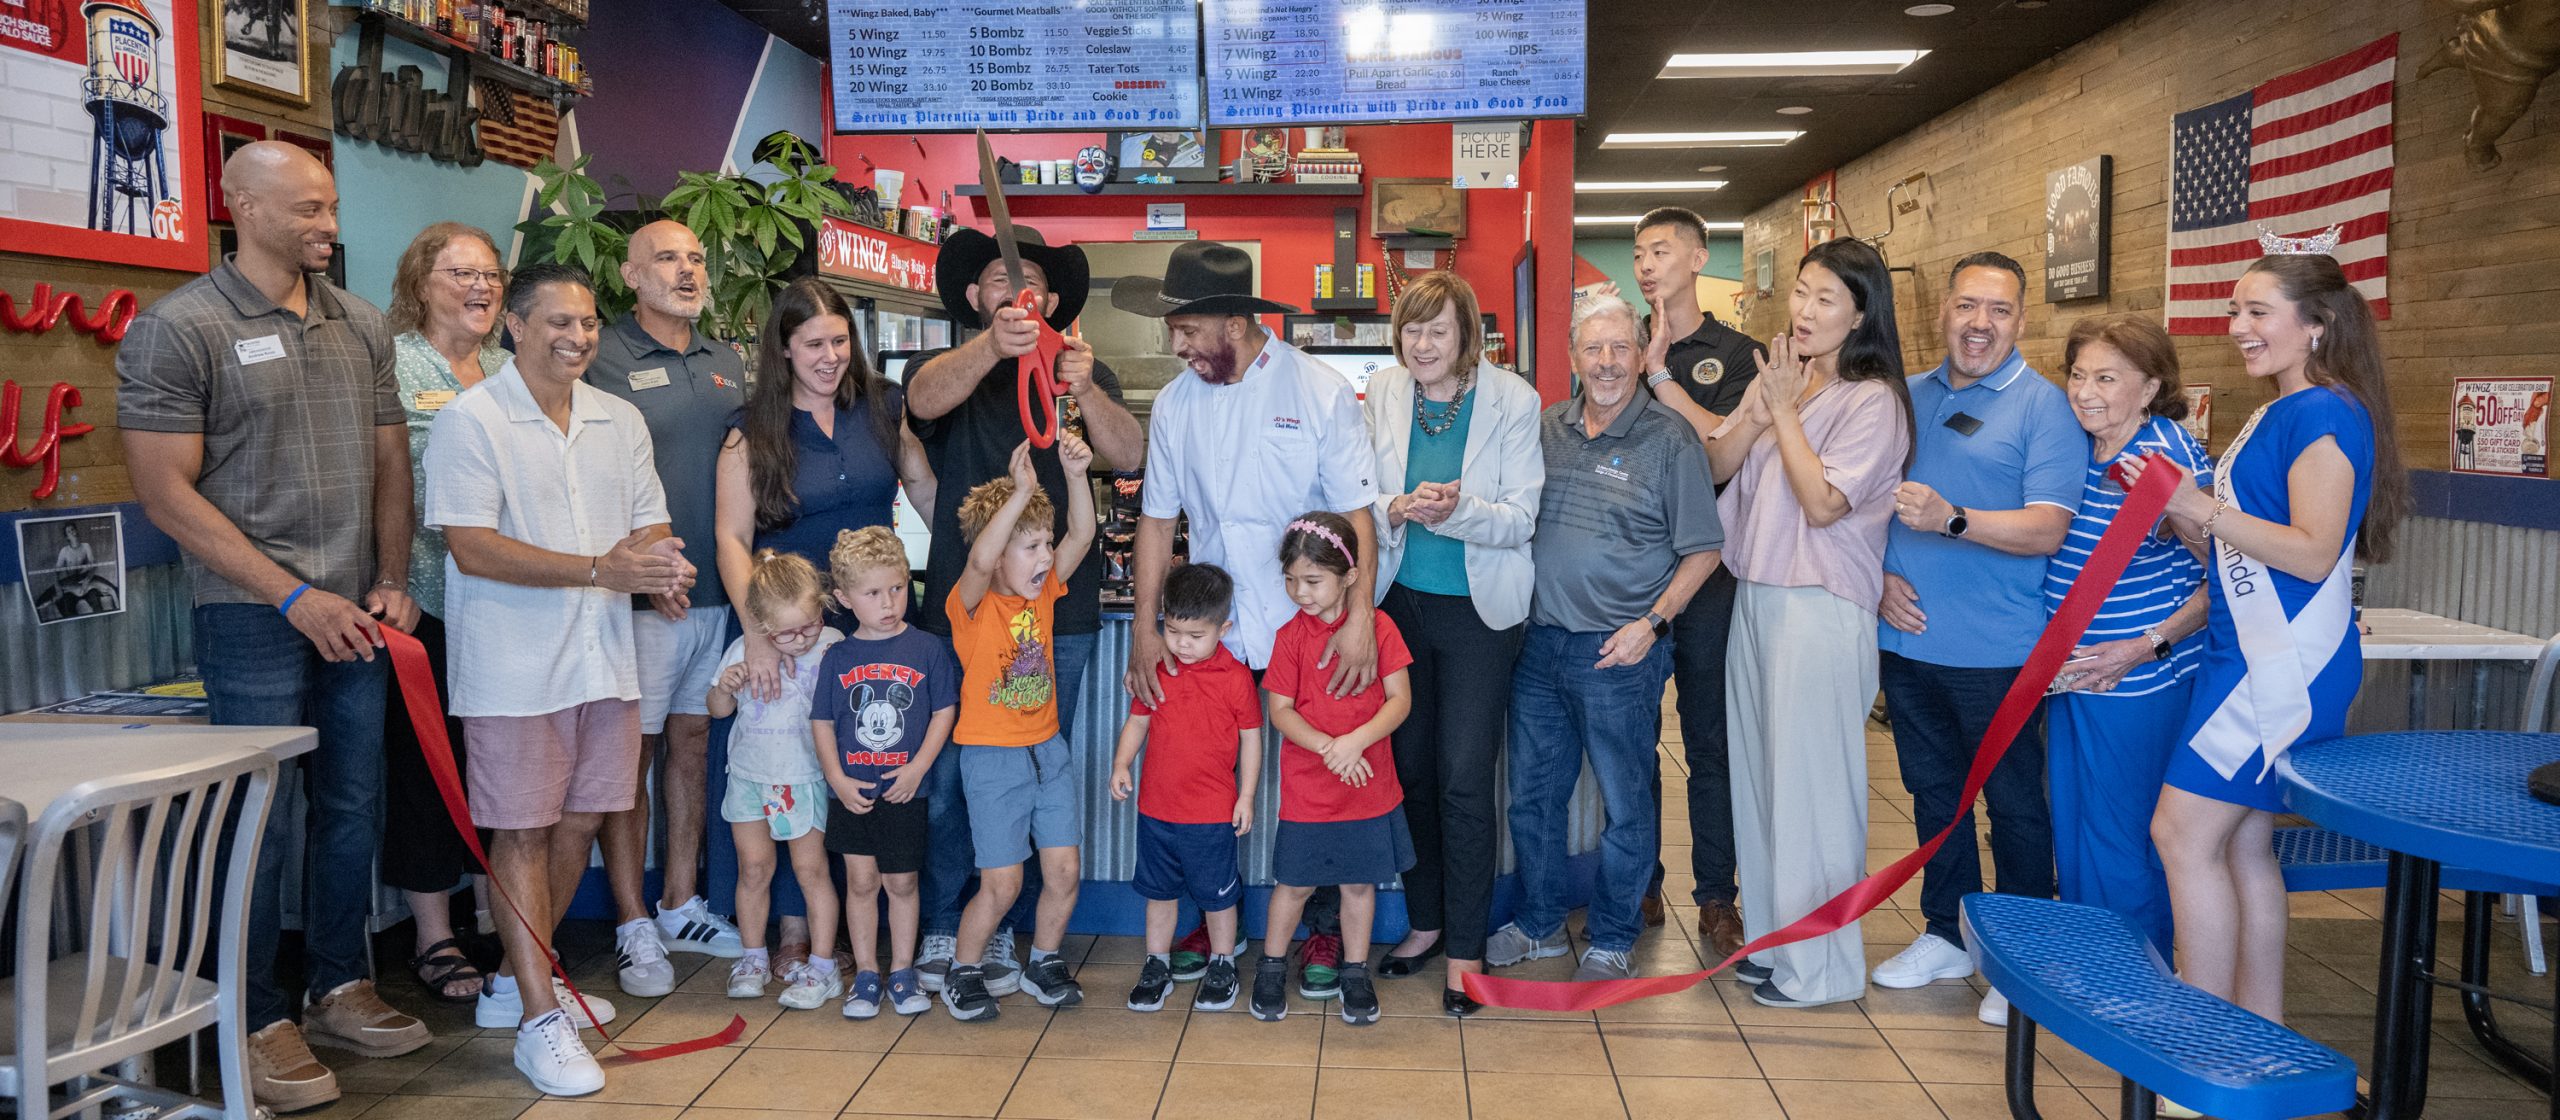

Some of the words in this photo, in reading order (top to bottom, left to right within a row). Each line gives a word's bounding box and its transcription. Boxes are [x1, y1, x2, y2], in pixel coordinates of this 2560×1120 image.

[881, 8, 912, 18] Baked,
[1476, 12, 1488, 21] 75
[1492, 11, 1524, 22] Wingz
[18, 18, 50, 36] SPICER
[970, 27, 977, 38] 5
[981, 26, 1024, 38] Bombz
[1044, 28, 1069, 37] 11.50
[1084, 26, 1120, 37] Veggie
[1295, 28, 1319, 37] 18.90
[22, 30, 53, 47] SAUCE
[848, 29, 856, 40] 5
[859, 28, 900, 42] Wingz
[922, 30, 946, 39] 11.50
[1223, 29, 1231, 40] 5
[1234, 28, 1276, 42] Wingz
[1475, 30, 1494, 40] 100
[1497, 29, 1529, 40] Wingz
[115, 36, 148, 54] PLACENTIA
[969, 45, 985, 56] 10
[989, 44, 1032, 56] Bombz
[1086, 44, 1131, 54] Coleslaw
[1168, 45, 1187, 54] 4.45
[849, 47, 864, 58] 10
[867, 46, 908, 60] Wingz
[922, 48, 946, 57] 19.75
[1045, 47, 1069, 55] 19.75
[1224, 49, 1232, 60] 7
[1236, 48, 1277, 61] Wingz
[1294, 49, 1319, 58] 21.10
[1401, 48, 1463, 61] FAMOUS
[849, 64, 864, 76] 15
[867, 63, 908, 77] Wingz
[922, 66, 947, 74] 26.75
[968, 63, 984, 74] 15
[988, 62, 1031, 74] Bombz
[1045, 65, 1070, 73] 26.75
[1088, 64, 1115, 73] Tater
[1117, 64, 1140, 73] Tots
[1295, 69, 1320, 77] 22.20
[1349, 69, 1368, 79] Pull
[1371, 68, 1401, 79] Apart
[1403, 67, 1433, 77] Garlic
[1492, 69, 1518, 77] Ranch
[1225, 68, 1232, 80] 9
[1237, 68, 1277, 81] Wingz
[1436, 70, 1461, 78] 10.50
[1554, 72, 1572, 80] 0.85
[923, 83, 948, 92] 33.10
[971, 80, 987, 91] 20
[991, 79, 1034, 91] Bombz
[1046, 82, 1071, 90] 33.10
[1114, 80, 1167, 89] DESSERT
[1376, 80, 1406, 89] Bread
[1500, 78, 1531, 86] Cheese
[849, 81, 865, 93] 20
[868, 81, 908, 95] Wingz
[1295, 88, 1320, 97] 25.50
[1092, 92, 1128, 101] Cookie
[1223, 88, 1238, 100] 11
[1242, 87, 1282, 101] Wingz
[1226, 105, 1284, 118] Serving
[1291, 102, 1358, 117] Placentia
[1367, 100, 1397, 113] with
[1406, 99, 1446, 114] Pride
[1455, 98, 1479, 110] and
[1488, 97, 1524, 109] Good
[1532, 96, 1568, 109] Food
[852, 111, 907, 124] Serving
[916, 110, 980, 123] Placentia
[988, 109, 1017, 122] with
[1026, 109, 1064, 123] Pride
[1073, 109, 1096, 120] and
[1105, 108, 1139, 120] Good
[1148, 108, 1182, 121] Food
[1461, 132, 1490, 143] PICK
[1495, 132, 1511, 143] UP
[1461, 144, 1511, 158] HERE
[2046, 173, 2066, 222] HOOD
[2067, 166, 2100, 208] FAMOUS
[155, 213, 183, 241] OC
[837, 229, 888, 274] WINGZ
[2048, 267, 2055, 279] DO
[2056, 264, 2070, 278] GOOD
[2071, 259, 2095, 275] BUSINESS
[2465, 383, 2491, 392] WINGZ
[2514, 398, 2525, 410] ALL
[2476, 396, 2497, 426] 50
[2497, 407, 2513, 424] OFF
[2513, 411, 2524, 422] DAY
[2479, 429, 2494, 437] FIRST
[2504, 439, 2521, 447] CARD
[1120, 485, 1139, 494] Candy
[838, 663, 926, 689] MICKEY
[847, 751, 908, 766] MOUSE
